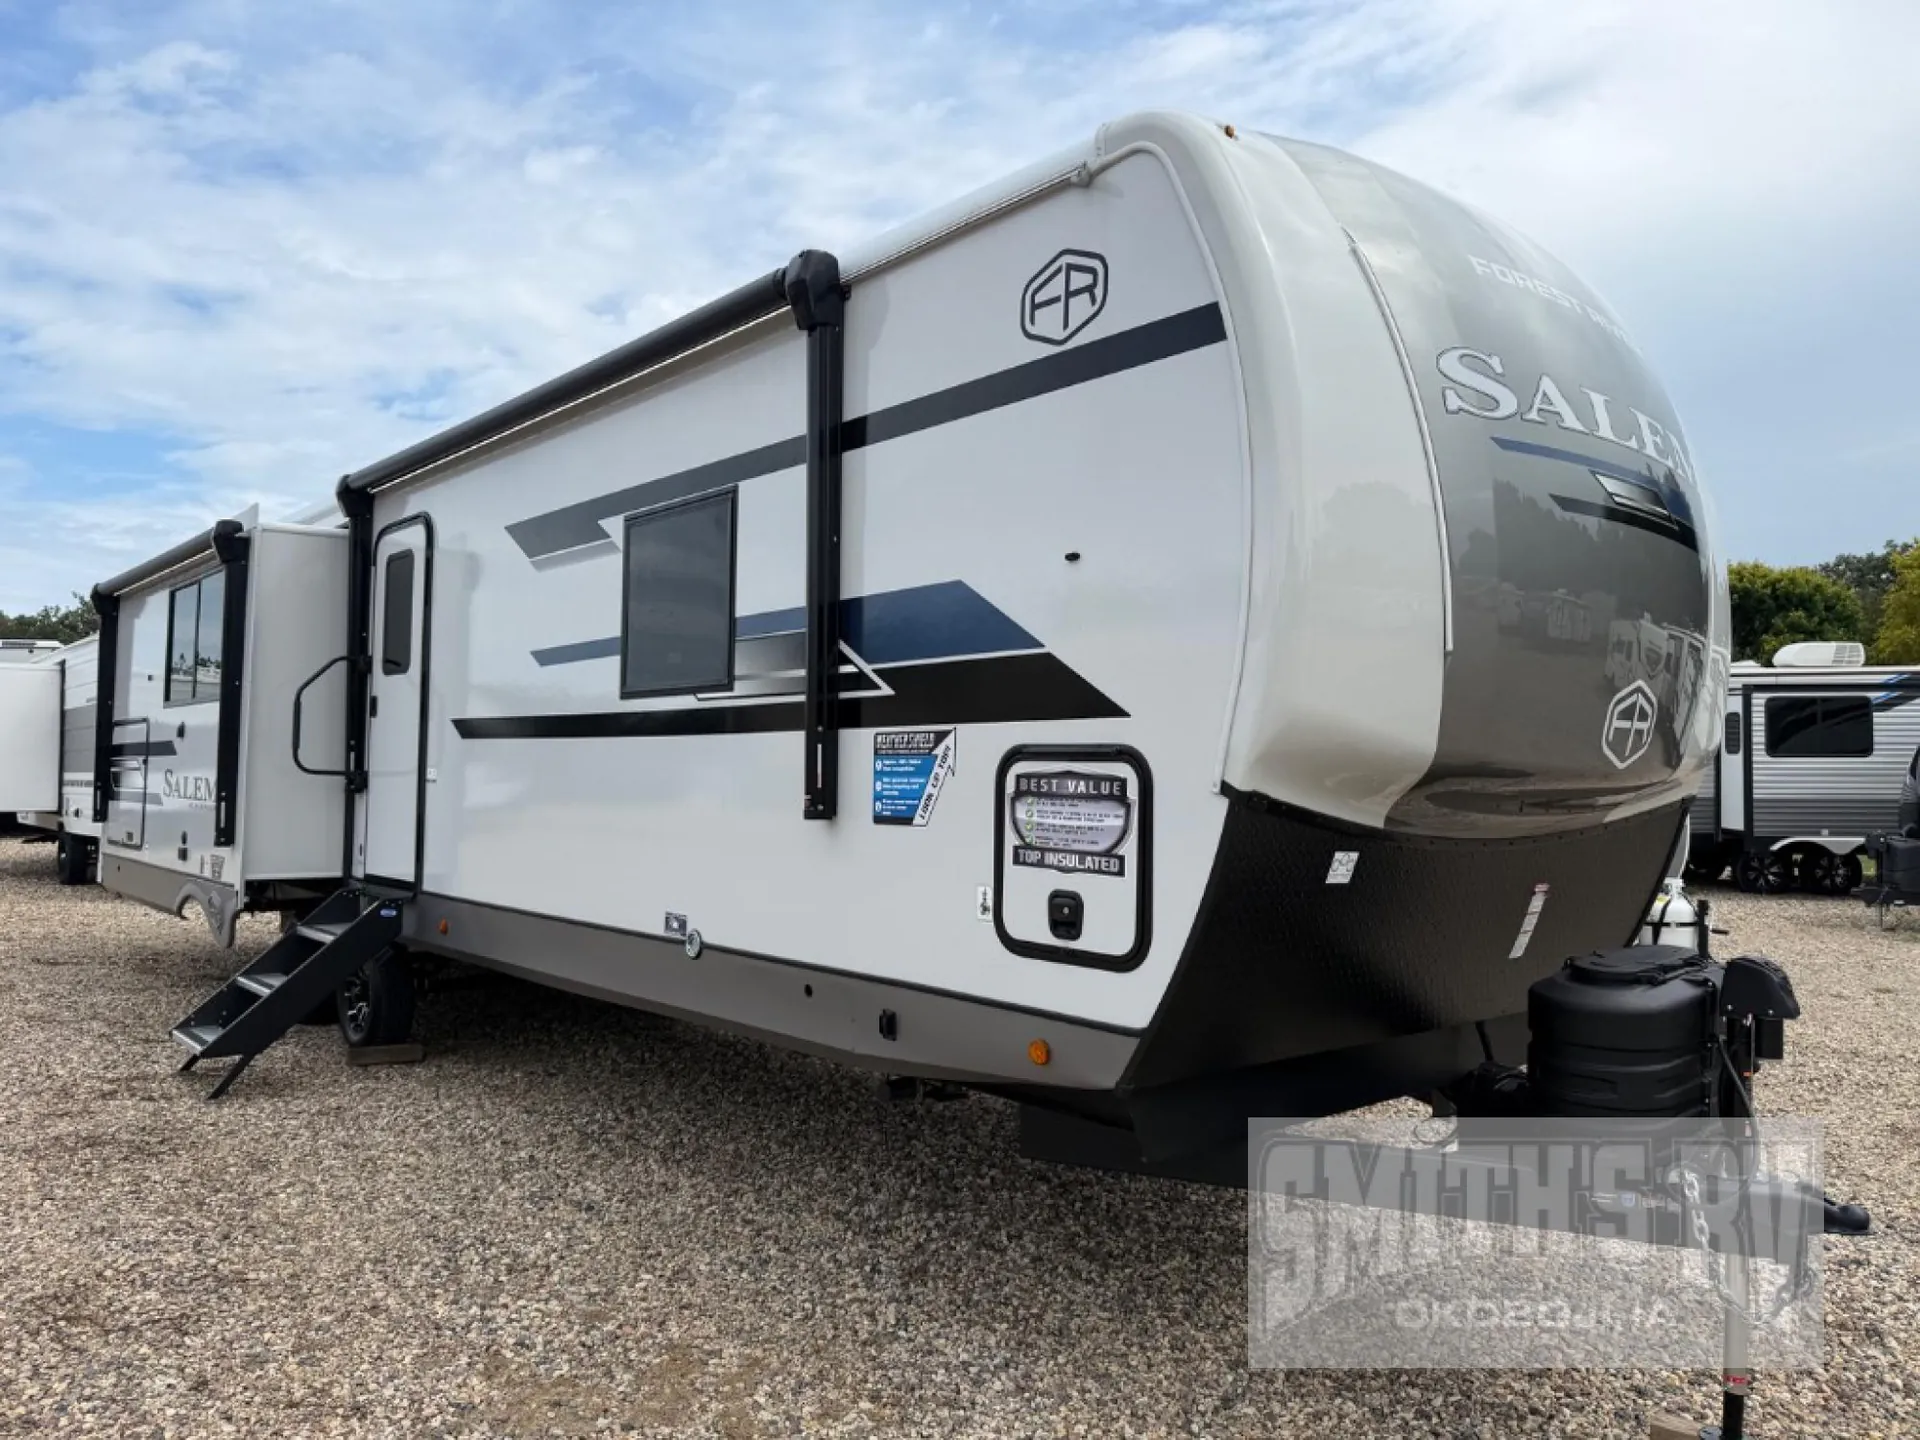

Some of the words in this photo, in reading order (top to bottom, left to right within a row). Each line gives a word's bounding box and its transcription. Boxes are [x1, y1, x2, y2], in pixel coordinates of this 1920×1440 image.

[1467, 254, 1582, 314] FOREST
[1436, 346, 1697, 484] SALEM
[1019, 778, 1060, 792] BEST
[1068, 780, 1122, 795] VALUE
[1018, 849, 1041, 864] TOP
[1044, 851, 1120, 873] INSULATED
